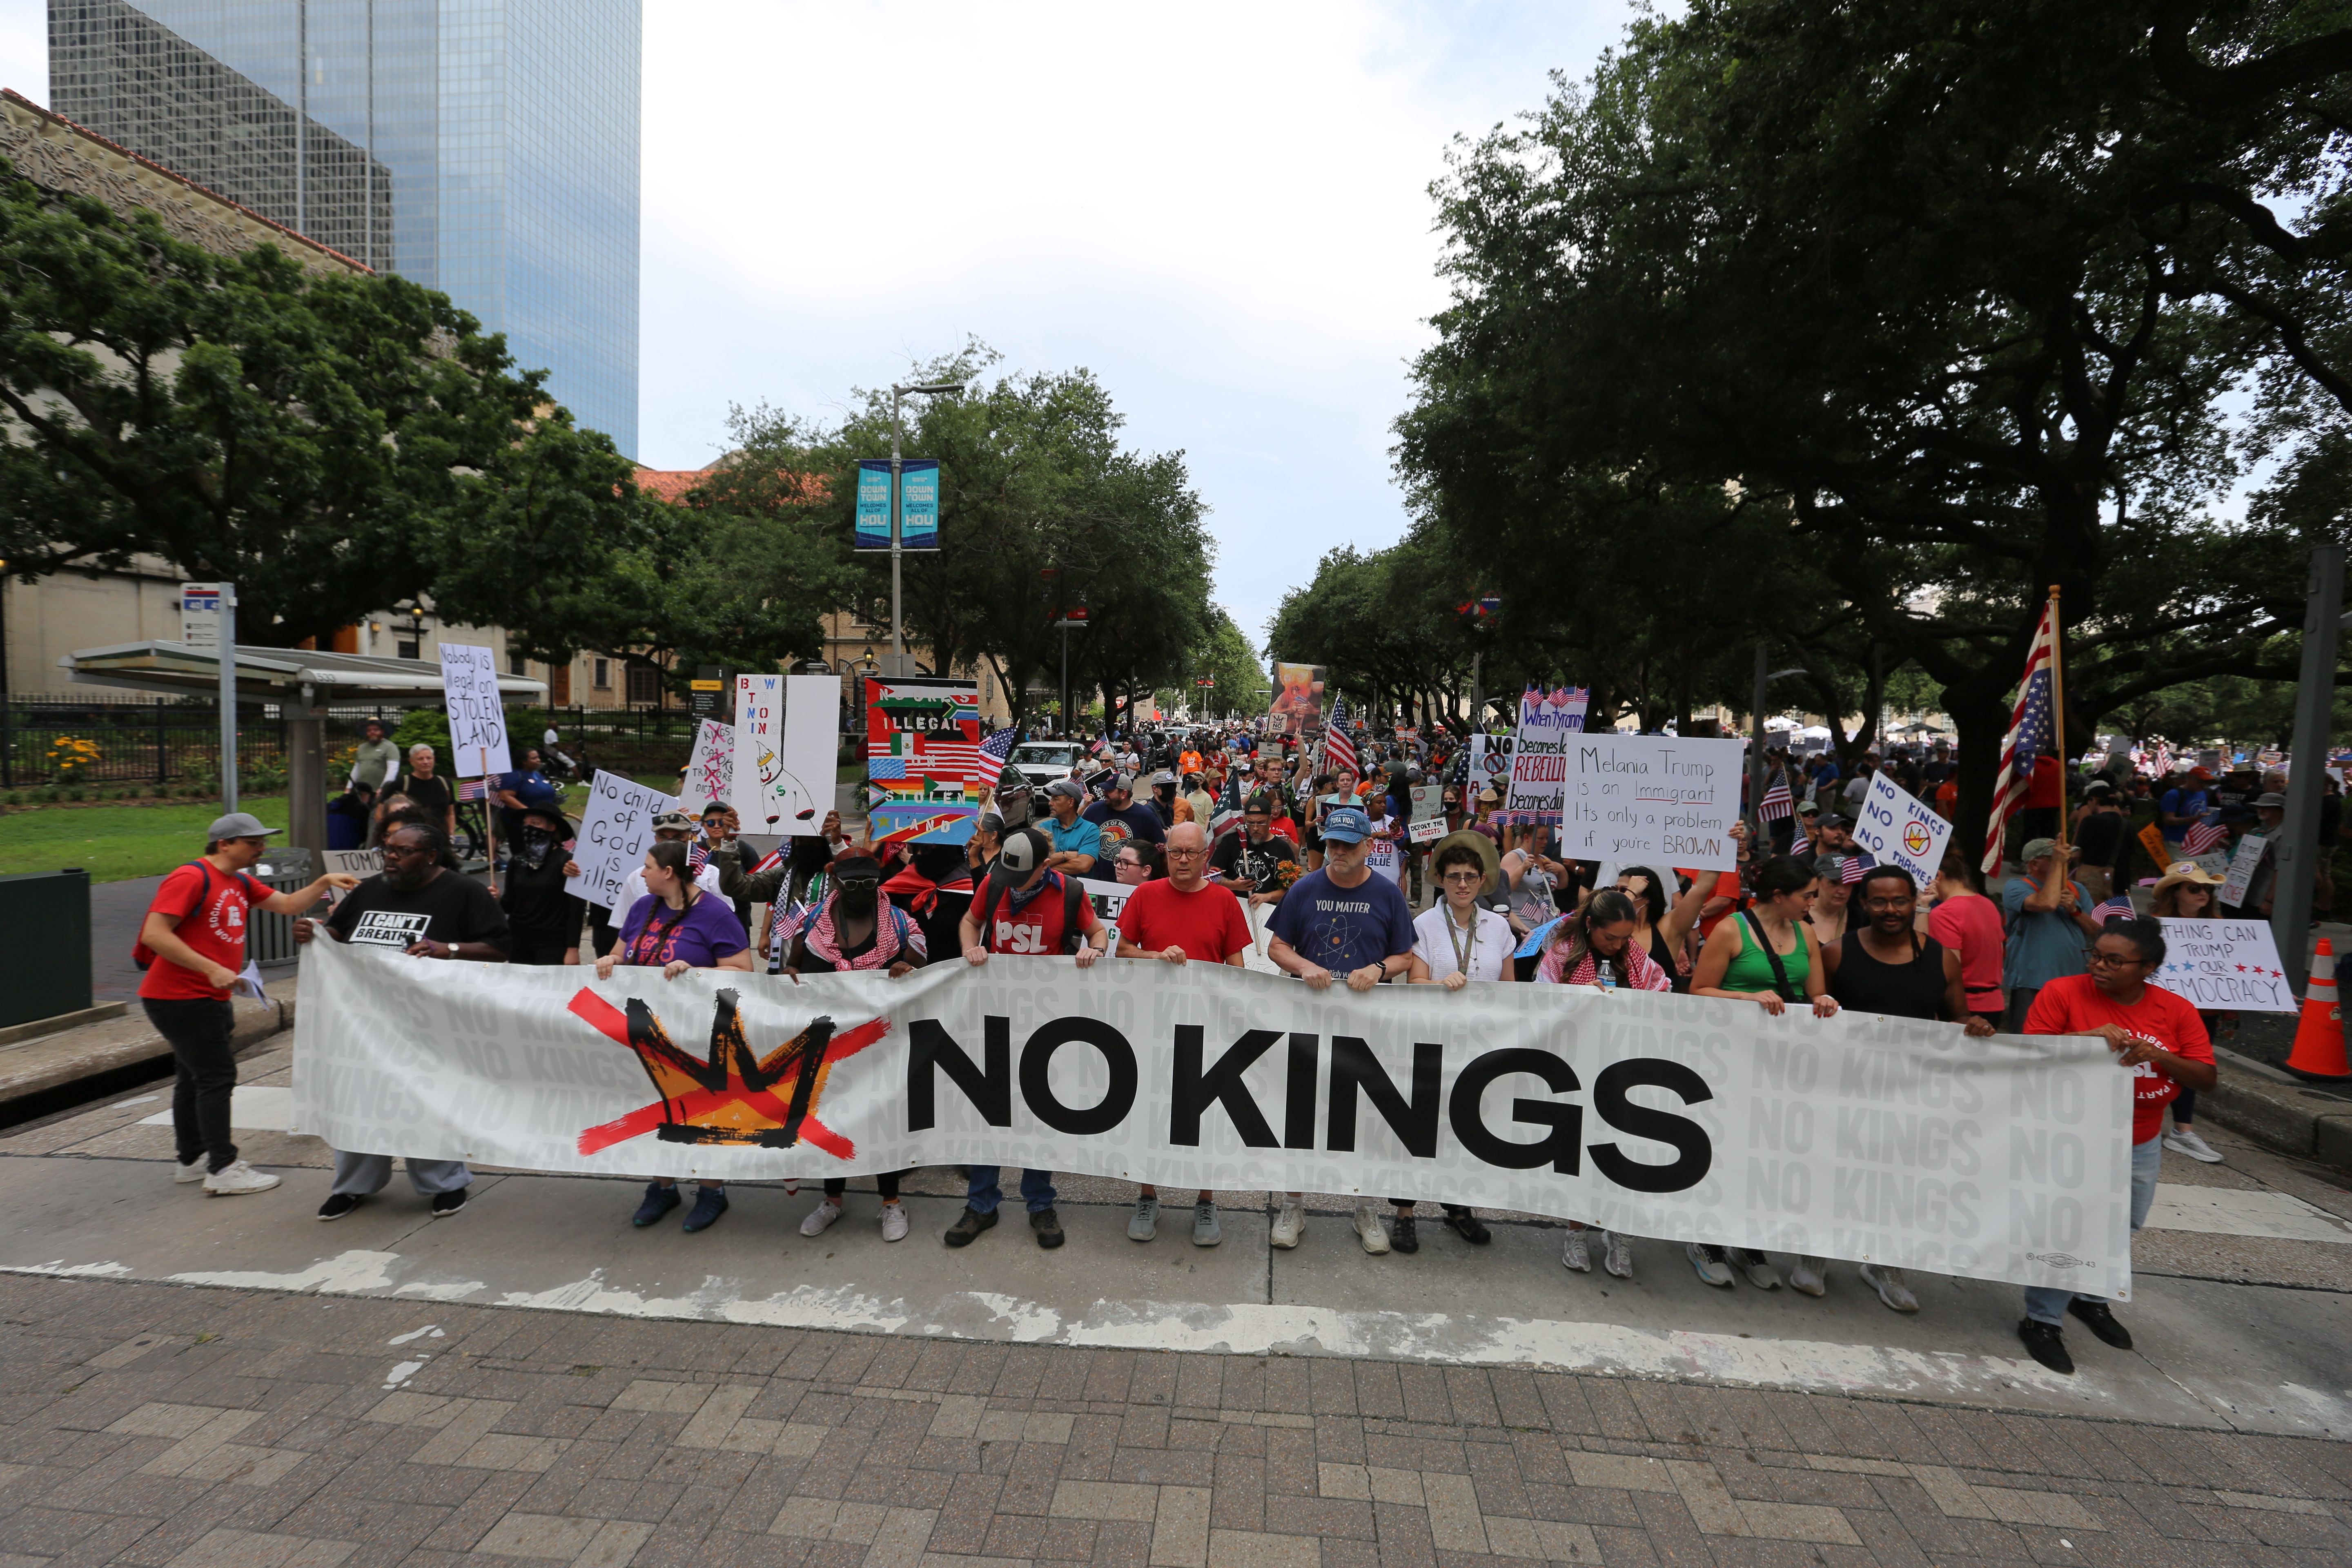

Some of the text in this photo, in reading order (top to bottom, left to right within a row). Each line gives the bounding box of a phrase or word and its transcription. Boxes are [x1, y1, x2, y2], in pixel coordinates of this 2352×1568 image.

[860, 514, 886, 525] HOU
[906, 514, 933, 525] HOU
[440, 644, 490, 673] Nobody is
[446, 669, 492, 697] illegal on
[741, 678, 775, 689] BOW
[449, 695, 501, 722] STOLEN
[748, 692, 768, 704] TO
[747, 707, 768, 719] NO
[883, 717, 961, 731] ILLEGAL
[1524, 702, 1586, 733] When tyranny
[454, 721, 501, 750] LAND
[1484, 735, 1513, 755] NO
[1517, 728, 1558, 754] becomes
[1581, 747, 1714, 784] Melania Trump
[594, 774, 664, 815] No child
[884, 790, 966, 805] STOLEN
[1509, 783, 1550, 811] becomes
[1577, 780, 1715, 805] is an Immigrant
[1576, 802, 1722, 831] It's only a problem
[1867, 800, 1892, 826] NO
[1876, 780, 1944, 835] NO KINGS
[615, 811, 637, 832] of
[895, 817, 950, 833] LAND
[1118, 822, 1131, 838] MEXICO
[1411, 823, 1430, 831] DEPORT
[1417, 828, 1440, 837] RACISTS
[591, 820, 642, 855] God
[1372, 844, 1392, 853] RED
[1585, 830, 1720, 856] if you're BROWN
[606, 852, 621, 872] is
[1368, 858, 1391, 866] BLUE
[1859, 828, 1932, 886] NO THRONES
[1316, 900, 1370, 913] YOU MATTER
[363, 913, 421, 929] I CAN'T
[356, 929, 415, 941] BREATH
[996, 919, 1048, 953] PSL
[2224, 926, 2257, 941] CAN
[2180, 943, 2234, 958] TRUMP
[2199, 961, 2229, 973] OUR
[2152, 978, 2280, 1005] DEMOCRACY
[1752, 1038, 1820, 1094] NO
[1839, 1047, 1984, 1114] KINGS
[2010, 1065, 2085, 1125] NO
[907, 1015, 1715, 1194] NO KINGS
[523, 1045, 642, 1090] KINGS
[1748, 1096, 1814, 1154] NO
[1836, 1105, 1982, 1176] KINGS
[2009, 1125, 2085, 1189] NO
[1746, 1156, 1811, 1215] NO
[1833, 1166, 1982, 1238] KINGS
[2009, 1188, 2083, 1252] NO
